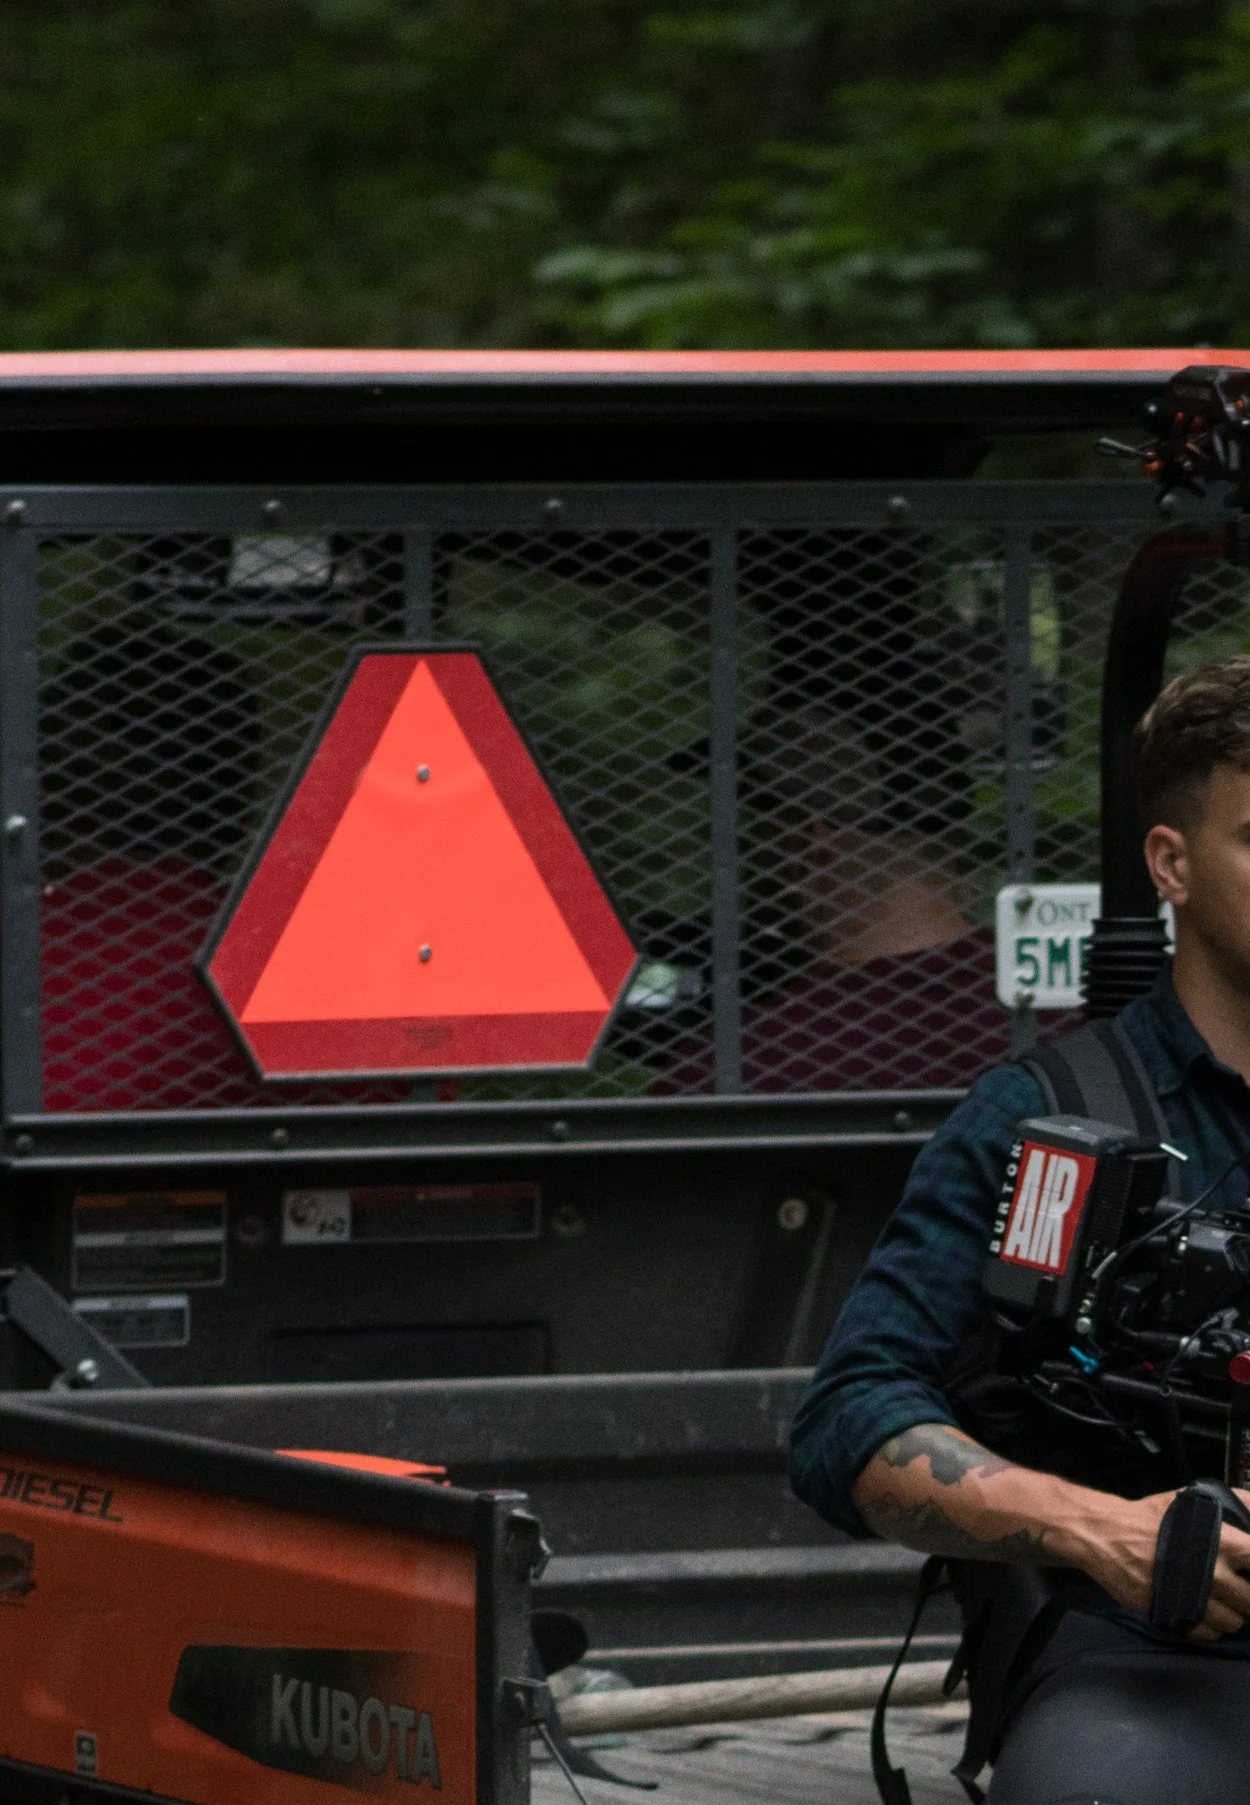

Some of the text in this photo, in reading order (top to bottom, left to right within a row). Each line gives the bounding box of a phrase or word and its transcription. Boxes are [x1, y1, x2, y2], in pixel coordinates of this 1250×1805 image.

[989, 1143, 1024, 1253] BURTON
[1004, 1149, 1080, 1269] AIR
[0, 1467, 124, 1523] DIESEL
[271, 1673, 443, 1791] KUBOTA
